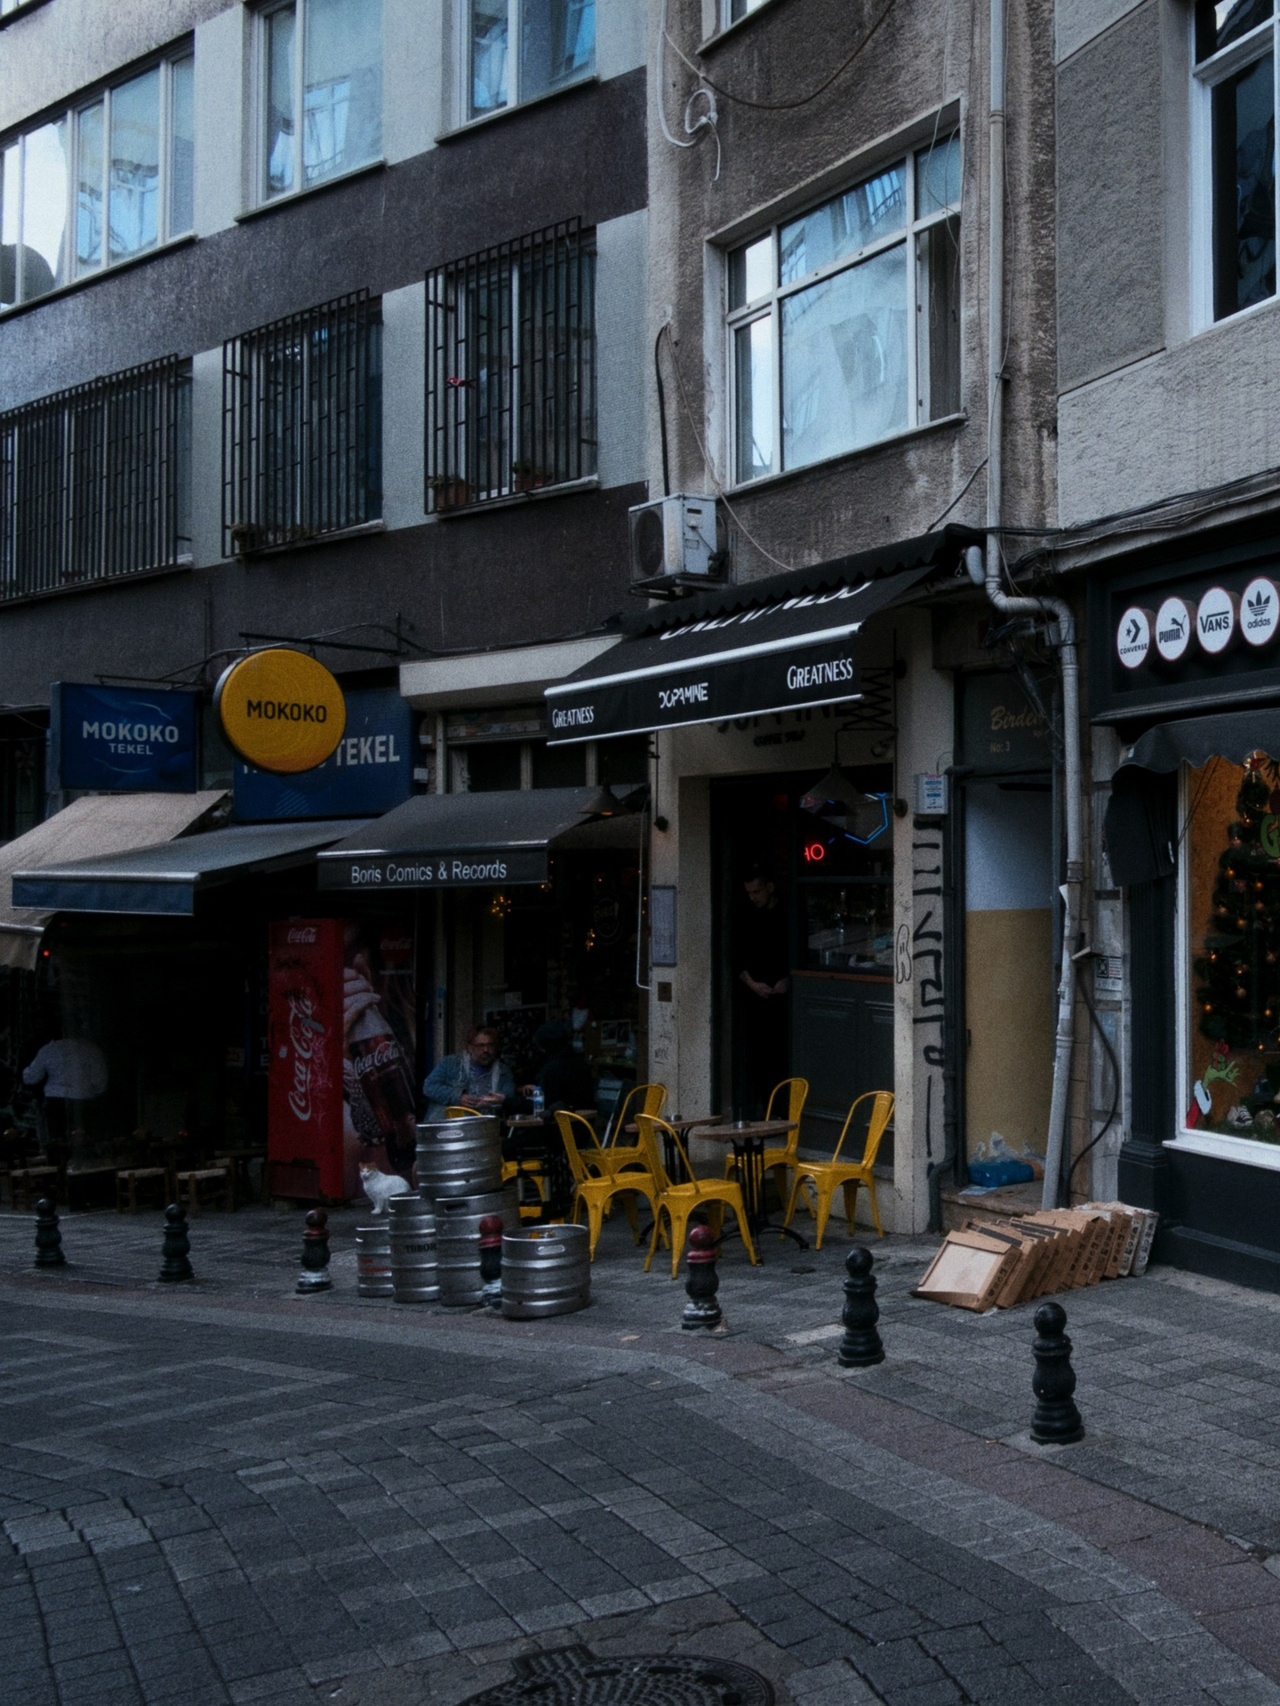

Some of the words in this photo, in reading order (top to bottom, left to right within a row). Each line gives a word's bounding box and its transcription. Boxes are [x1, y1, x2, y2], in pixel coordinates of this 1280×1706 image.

[1199, 611, 1230, 634] VANS
[1247, 617, 1271, 629] adidas
[1159, 628, 1183, 644] PUMA
[1120, 643, 1148, 655] CONVERSE
[787, 657, 854, 691] GREATNESS
[247, 699, 328, 724] MOKOKO
[552, 706, 595, 729] GREATNESS
[82, 720, 180, 744] MOKOKO
[108, 742, 154, 756] TEKEL
[335, 734, 401, 767] TEKEL
[351, 864, 382, 884] Boris
[386, 862, 433, 883] Comics
[438, 861, 448, 880] &
[452, 859, 507, 880] Records
[287, 927, 317, 944] Coca-Cola
[288, 993, 314, 1122] Coca-Cola
[406, 1242, 437, 1254] TUBOR
